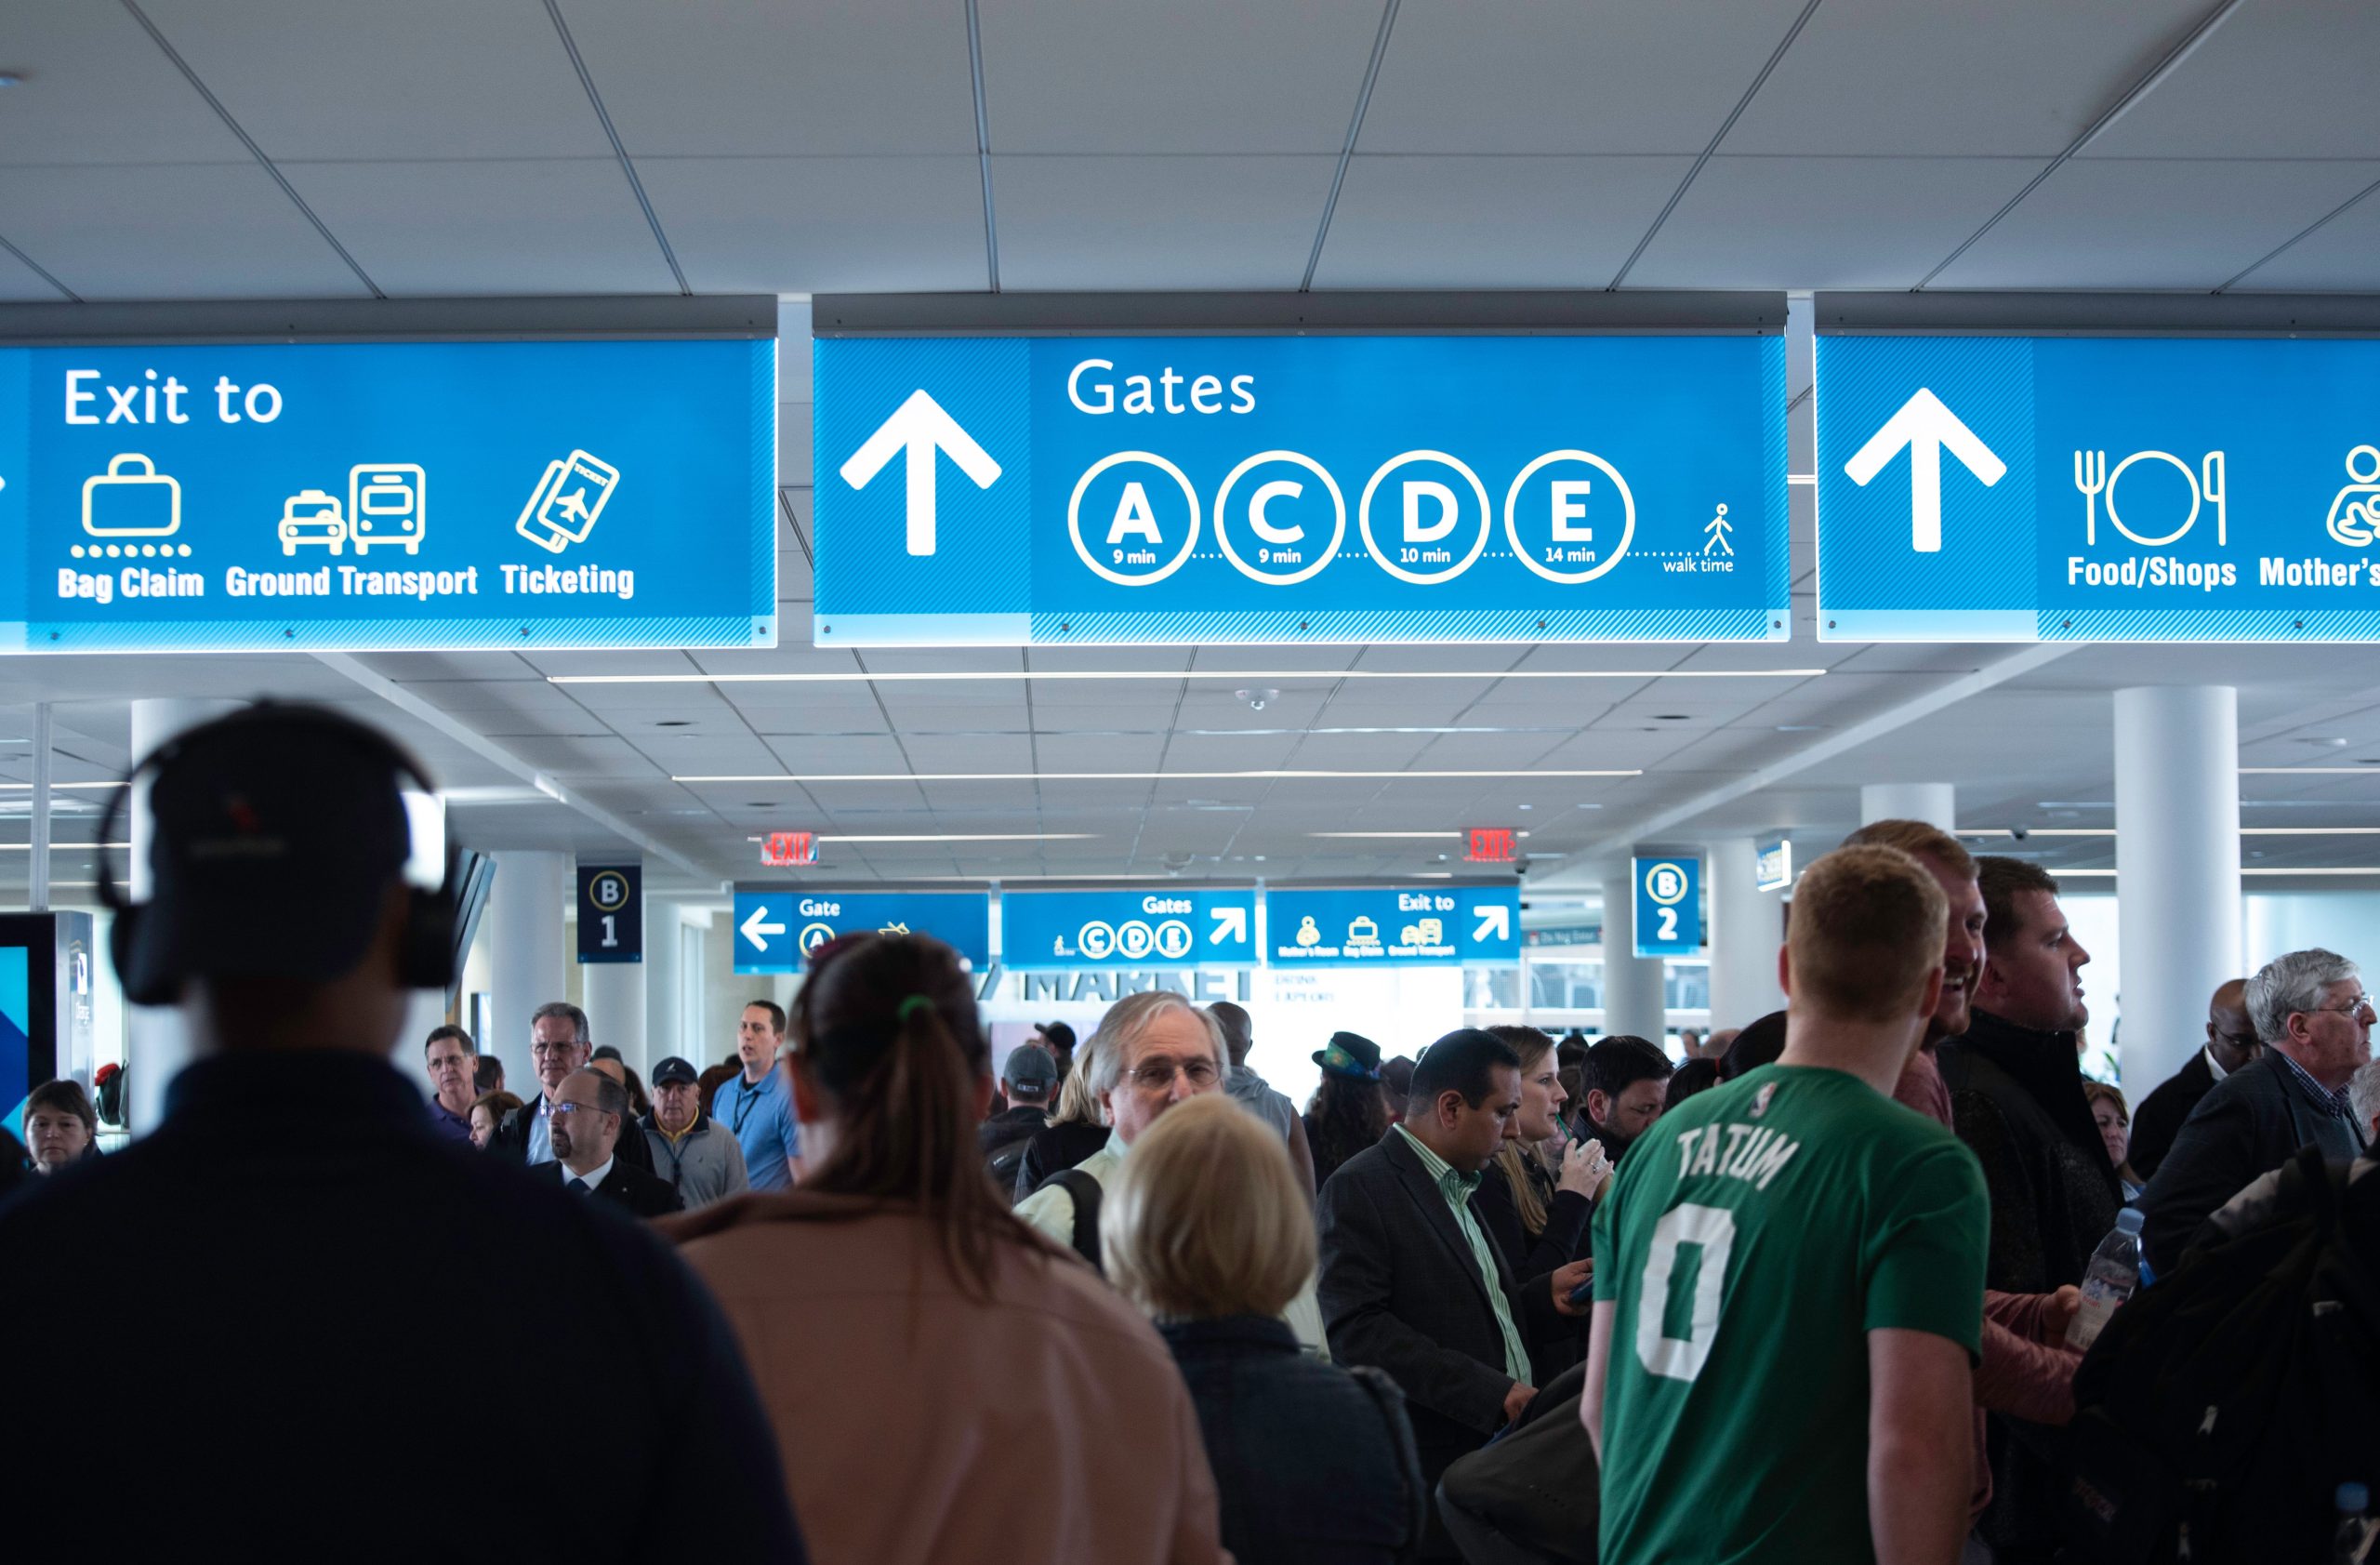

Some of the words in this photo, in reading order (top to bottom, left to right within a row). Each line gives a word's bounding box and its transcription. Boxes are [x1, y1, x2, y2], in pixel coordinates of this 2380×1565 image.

[66, 369, 189, 424] Exit
[215, 377, 283, 425] to
[1068, 359, 1255, 415] Gates
[1106, 482, 1163, 544] A
[1249, 480, 1305, 544] C
[1403, 481, 1459, 543] D
[1551, 480, 1593, 542] E
[1113, 549, 1124, 564] 9
[1128, 549, 1156, 564] min
[1259, 548, 1270, 564] 9
[1274, 548, 1302, 564] min
[1400, 548, 1419, 563] 10
[1422, 548, 1451, 563] min
[1545, 548, 1564, 562] 14
[1567, 547, 1595, 562] min
[1663, 558, 1697, 573] walk
[1700, 558, 1734, 573] time
[58, 568, 113, 603] Bag
[121, 566, 205, 598] Claim
[226, 566, 330, 598] Ground
[338, 565, 478, 602] Transport
[500, 564, 634, 600] Ticketing
[2068, 556, 2237, 592] Food/Shops
[770, 832, 812, 861] EXIT
[1471, 829, 1512, 857] EXIT
[601, 879, 619, 904] B
[1657, 870, 1678, 897] B
[799, 898, 840, 917] Gate
[1142, 895, 1193, 914] Gates
[1398, 893, 1432, 911] Exit
[1435, 895, 1455, 911] to
[601, 915, 618, 948] 1
[1087, 928, 1104, 948] C
[1127, 927, 1146, 948] D
[1166, 927, 1182, 948] E
[1657, 907, 1678, 941] 2
[1677, 1122, 1800, 1191] TATUM
[1636, 1202, 1737, 1382] 0
